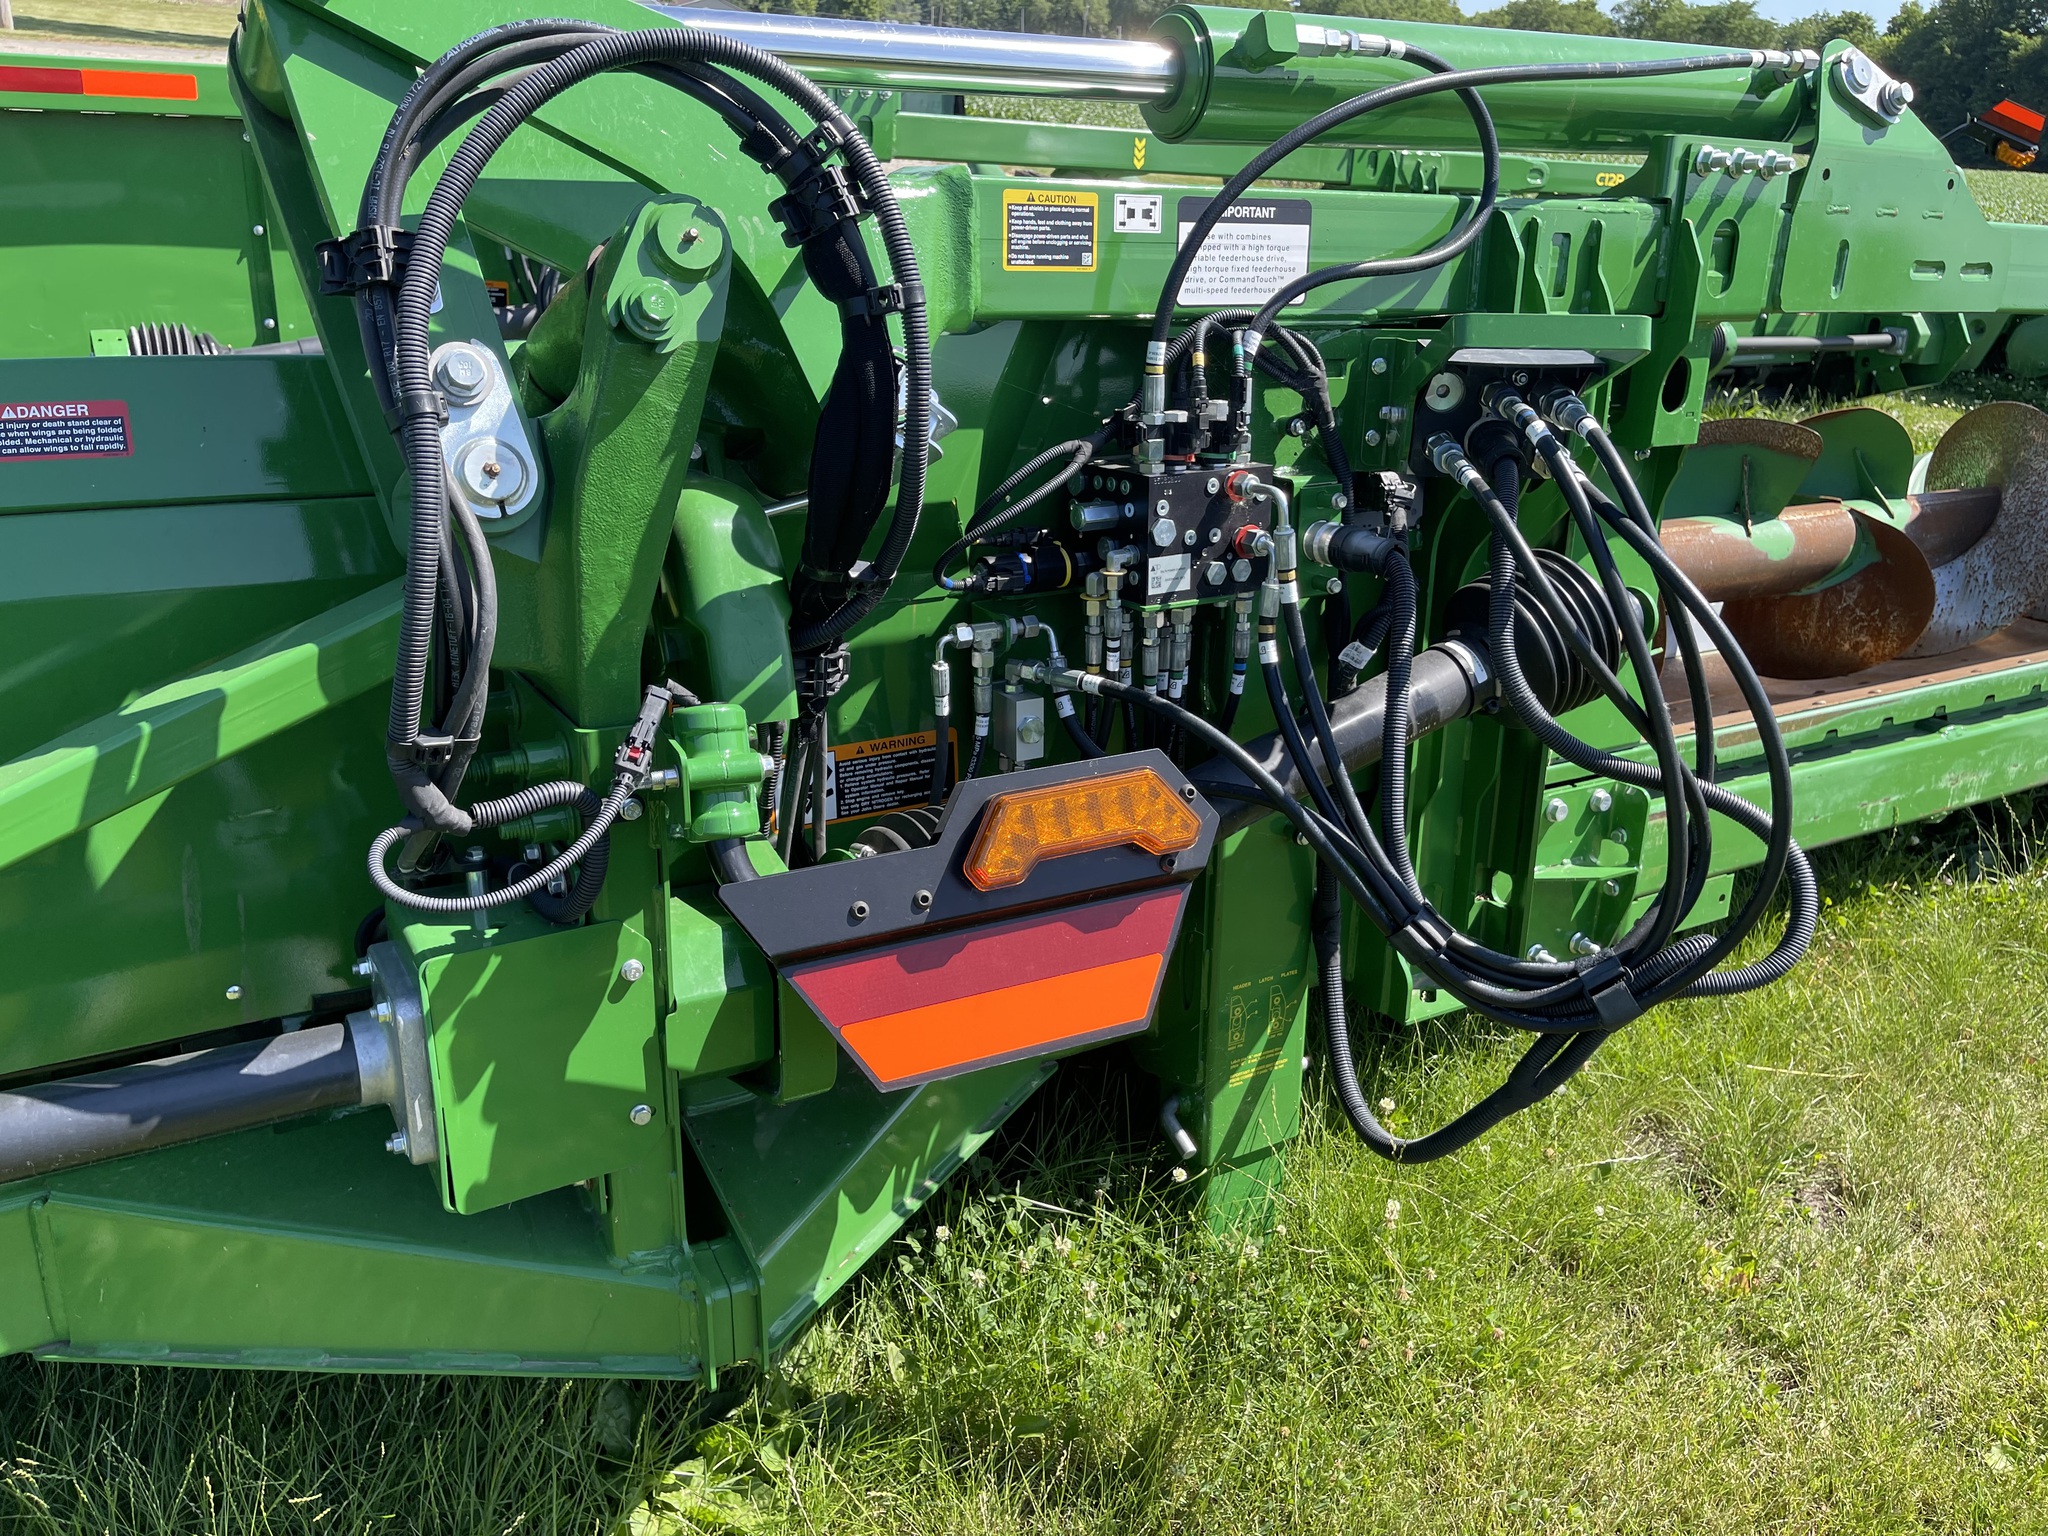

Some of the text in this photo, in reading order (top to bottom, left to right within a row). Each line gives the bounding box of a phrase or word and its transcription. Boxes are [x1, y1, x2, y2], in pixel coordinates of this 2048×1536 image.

[446, 27, 503, 61] ALFAGOMMA
[1038, 194, 1077, 204] CAUTION
[1221, 206, 1276, 218] PORTANT
[1236, 233, 1271, 241] combines
[1199, 244, 1221, 253] ipped
[1224, 243, 1239, 251] with
[1248, 243, 1265, 253] high
[1266, 245, 1290, 253] torque
[1194, 254, 1287, 263] riable feederhouse drive,
[1204, 265, 1229, 274] torque
[1231, 265, 1249, 273] fixed
[1251, 264, 1296, 273] feederhouse
[1184, 275, 1207, 284] drive,
[1184, 285, 1228, 295] multi-speed
[1230, 285, 1275, 294] feederhouse
[377, 314, 387, 326] EN
[382, 341, 393, 357] R17
[16, 404, 89, 418] DANGER
[6, 422, 29, 430] injury
[42, 420, 65, 428] death
[67, 419, 89, 427] stand
[32, 429, 56, 437] wings
[72, 427, 96, 436] being
[97, 426, 123, 434] folded
[25, 436, 72, 445] Mechanical
[85, 435, 124, 444] hydraulic
[19, 445, 41, 453] allow
[43, 445, 68, 453] wings
[95, 442, 126, 451] rapidly.
[870, 736, 926, 752] WARNING
[878, 759, 897, 767] pressure.
[854, 768, 874, 776] removing
[875, 765, 893, 773] hydraulic
[845, 775, 865, 783] changing
[877, 775, 895, 783] hydraulic
[861, 787, 886, 796] information.
[871, 797, 893, 805] NITROGEN
[902, 791, 922, 799] recharging
[1233, 969, 1298, 992] HEADER LATCH PLATES
